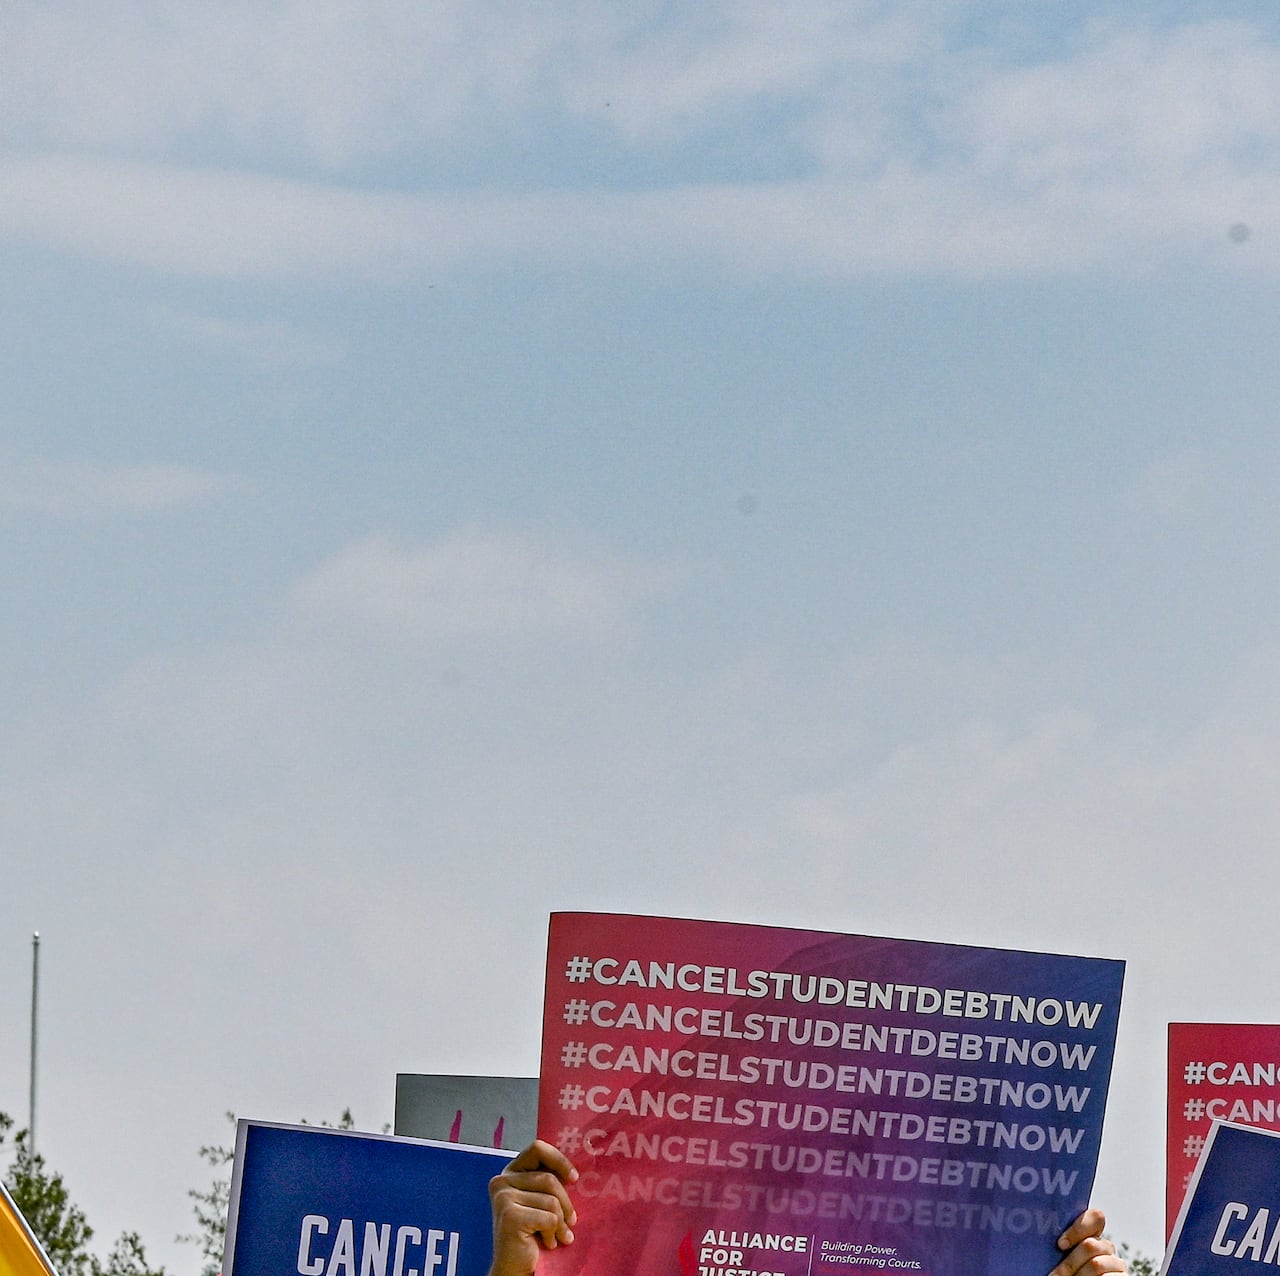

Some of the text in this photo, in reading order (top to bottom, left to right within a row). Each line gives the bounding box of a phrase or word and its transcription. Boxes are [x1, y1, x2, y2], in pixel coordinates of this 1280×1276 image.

[565, 956, 1102, 1029] #CANCELSTUDENTDEBTNOW
[562, 999, 1097, 1071] #CANCELSTUDENTDEBTNOW
[560, 1041, 1091, 1113] #CANCELSTUDENTDEBTNOW
[558, 1084, 1085, 1154] #CANCELSTUDENTDEBTNOW
[556, 1126, 1079, 1196] #CANCELSTUDENTDEBTNOW
[568, 1171, 1063, 1236] CANCELSTUDENTDEBTNOW
[699, 1248, 744, 1266] FOR
[701, 1229, 808, 1253] ALLIANCE
[819, 1253, 922, 1270] Transforming Courts.
[821, 1240, 898, 1256] Building Power.
